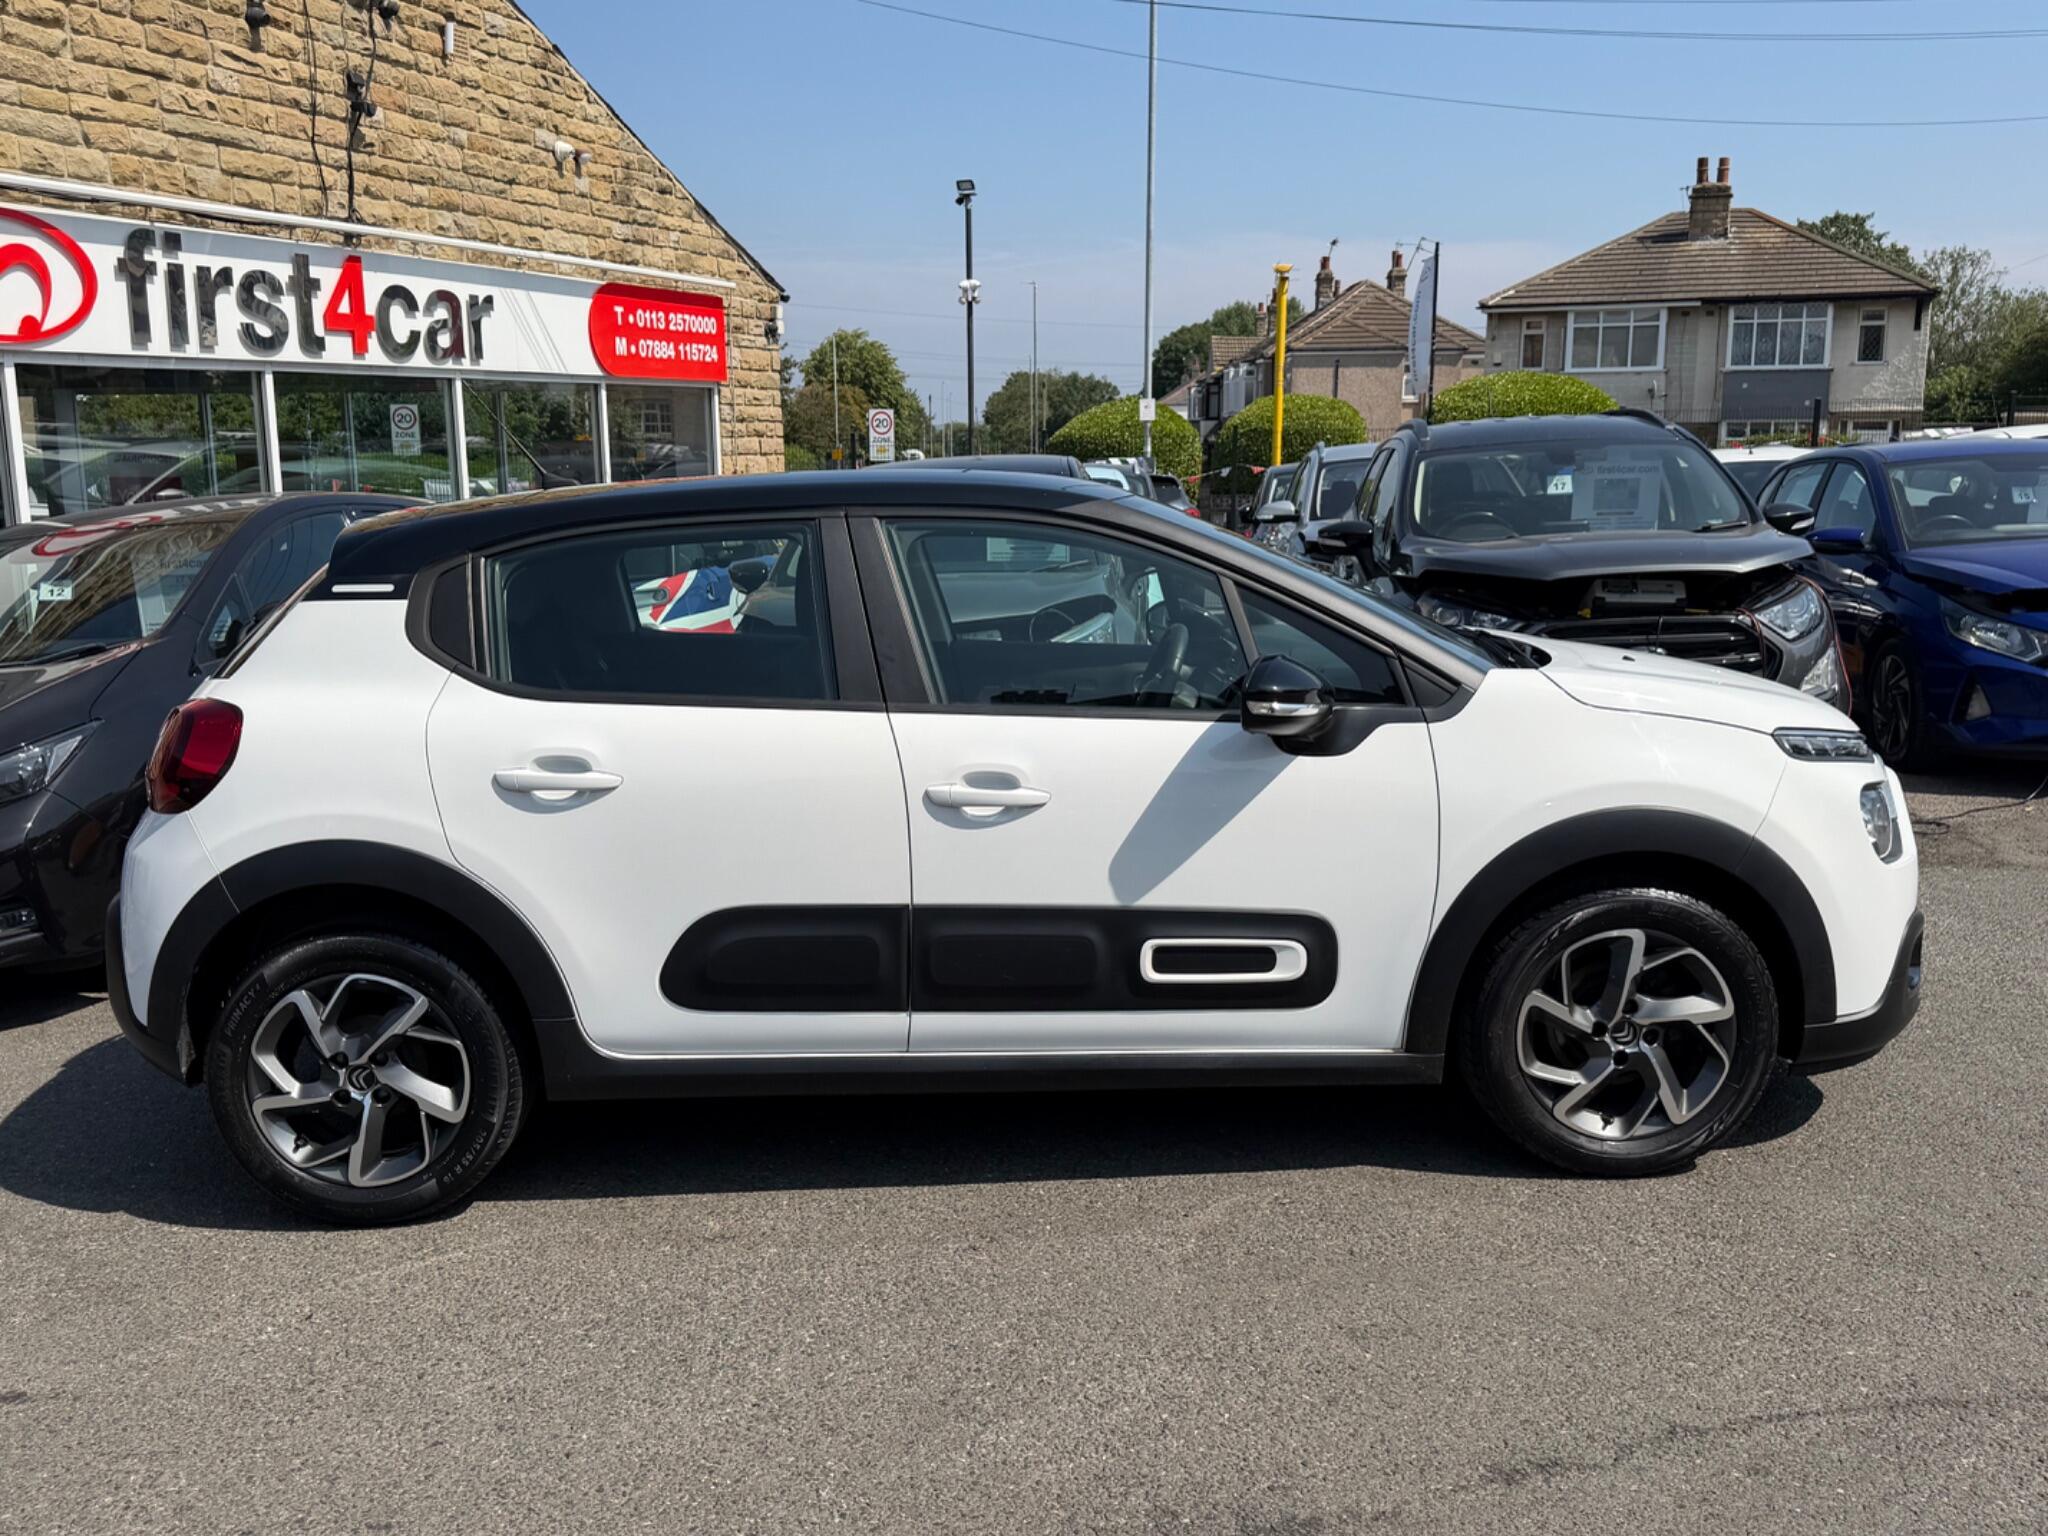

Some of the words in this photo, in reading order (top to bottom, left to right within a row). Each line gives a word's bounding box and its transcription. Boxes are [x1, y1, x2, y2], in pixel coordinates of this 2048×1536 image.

[116, 228, 494, 362] first4car
[614, 306, 624, 325] T
[636, 308, 665, 329] 0113
[668, 312, 716, 334] 2570000
[615, 337, 627, 356] M
[638, 339, 675, 360] 07884
[678, 342, 718, 363] 115724
[396, 413, 411, 423] 20
[875, 418, 889, 428] 20
[1553, 482, 1566, 490] 17
[48, 588, 65, 597] 12
[224, 987, 256, 1038] PRIMACY
